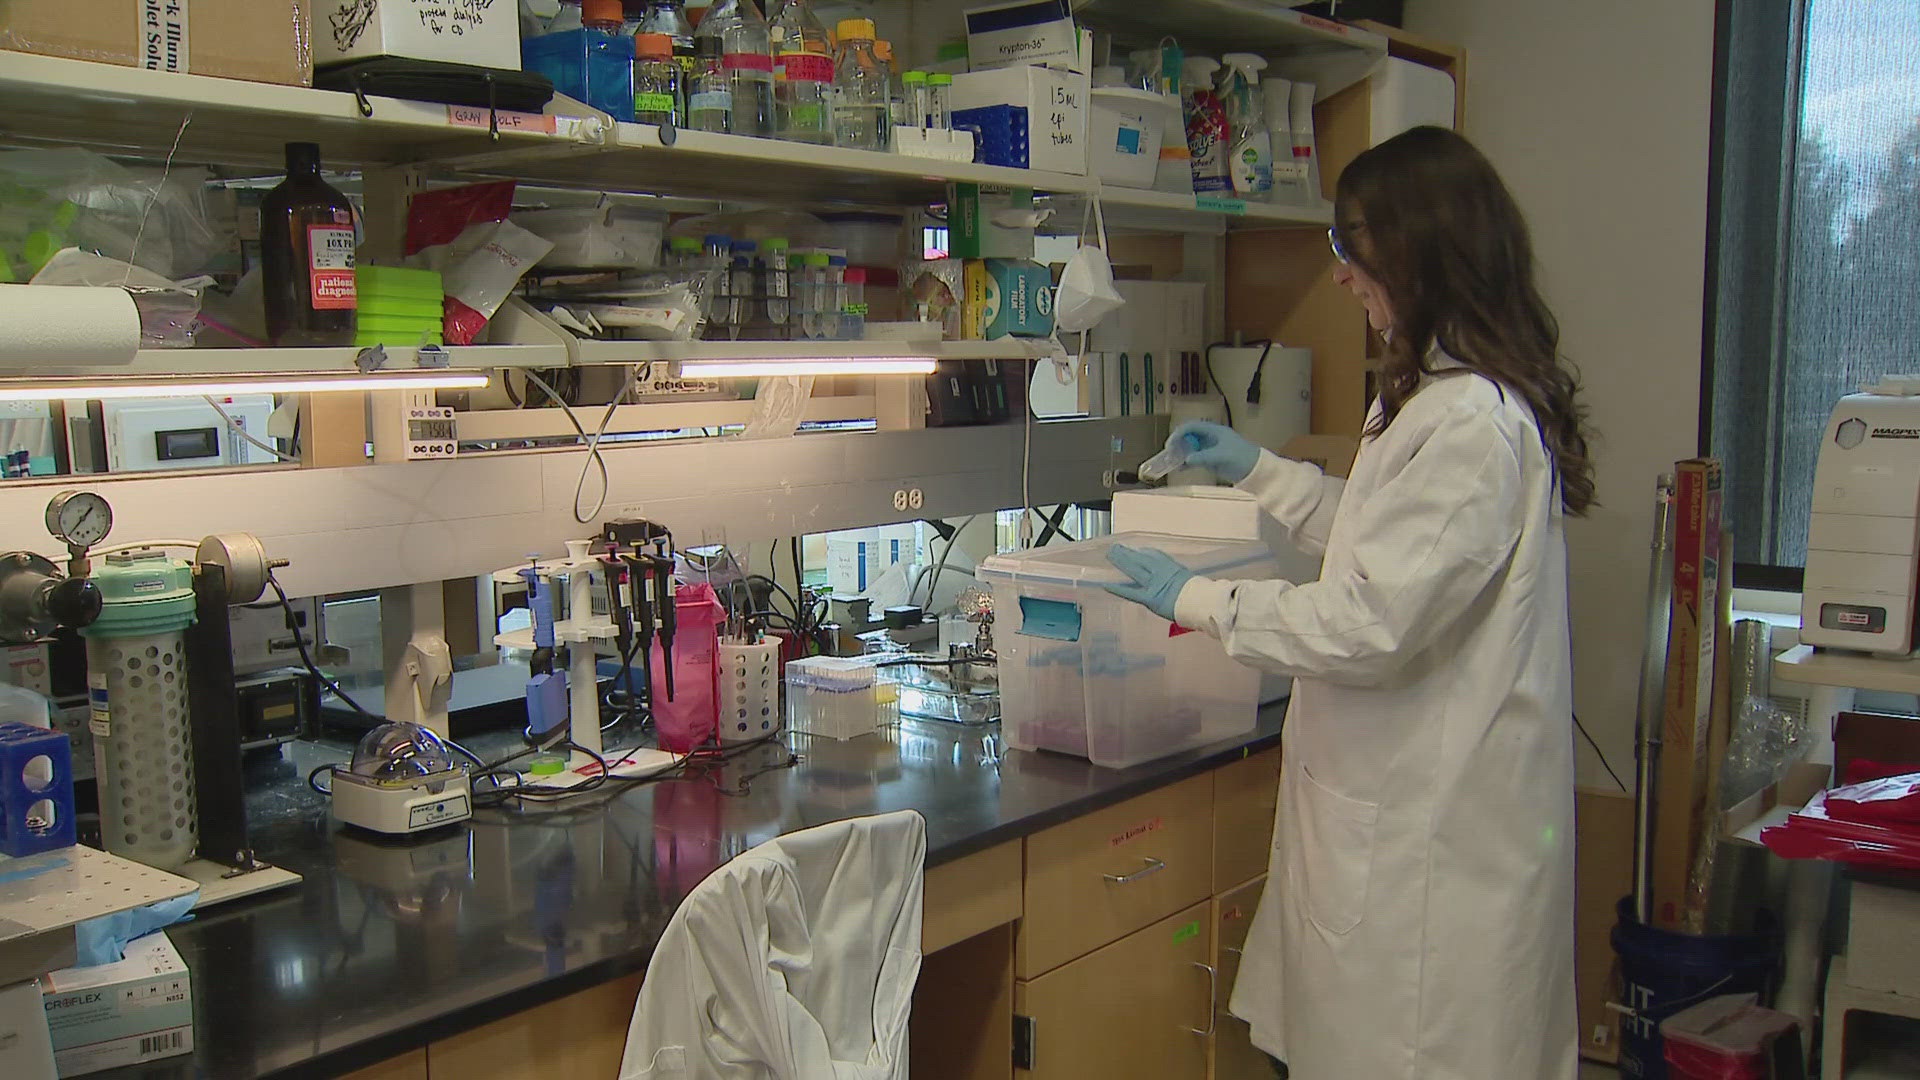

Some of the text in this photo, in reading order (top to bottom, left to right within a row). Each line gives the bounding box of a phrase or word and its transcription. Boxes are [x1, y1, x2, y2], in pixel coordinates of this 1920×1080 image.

[455, 110, 522, 127] GRAY OLF
[1051, 132, 1073, 145] tubes
[327, 239, 342, 248] 10X
[1018, 275, 1026, 327] LABORATORY
